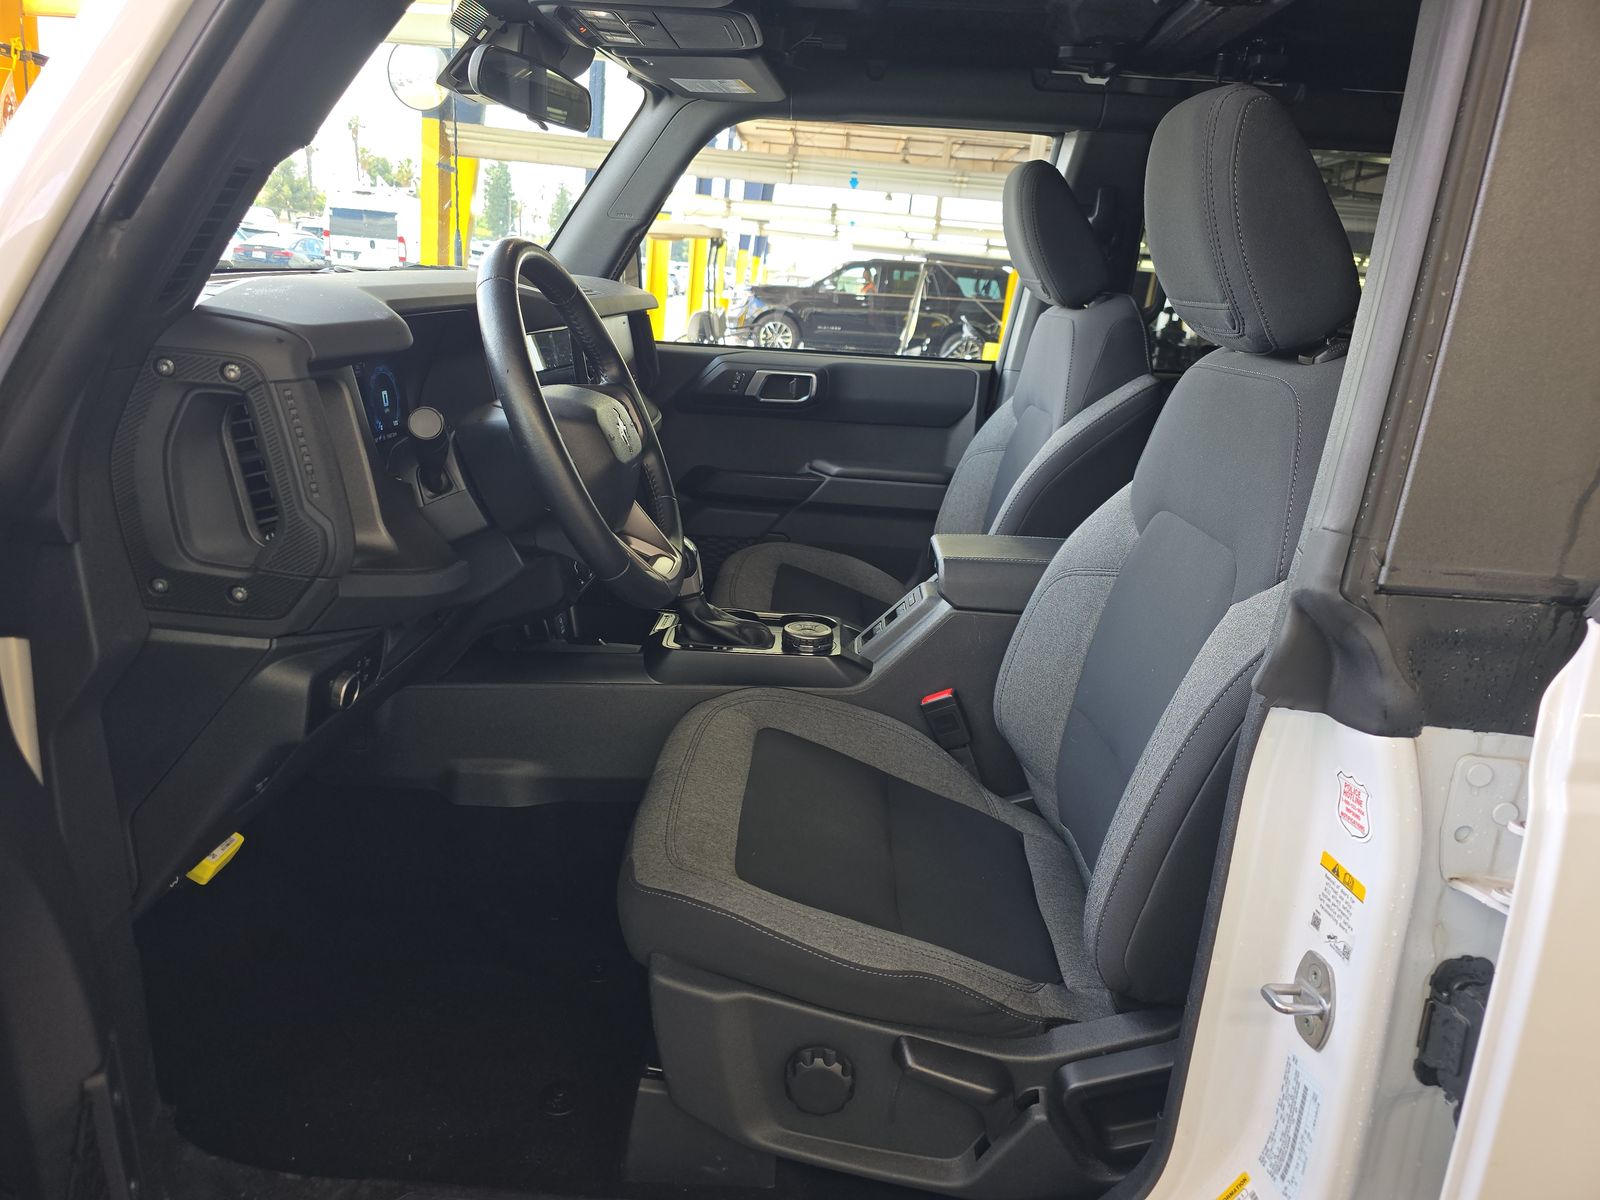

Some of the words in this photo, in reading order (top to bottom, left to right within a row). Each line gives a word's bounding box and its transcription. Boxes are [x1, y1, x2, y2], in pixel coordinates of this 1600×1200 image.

[283, 388, 320, 499] BRONCO
[1344, 781, 1360, 798] POLICE
[1342, 791, 1363, 808] HOTLINE
